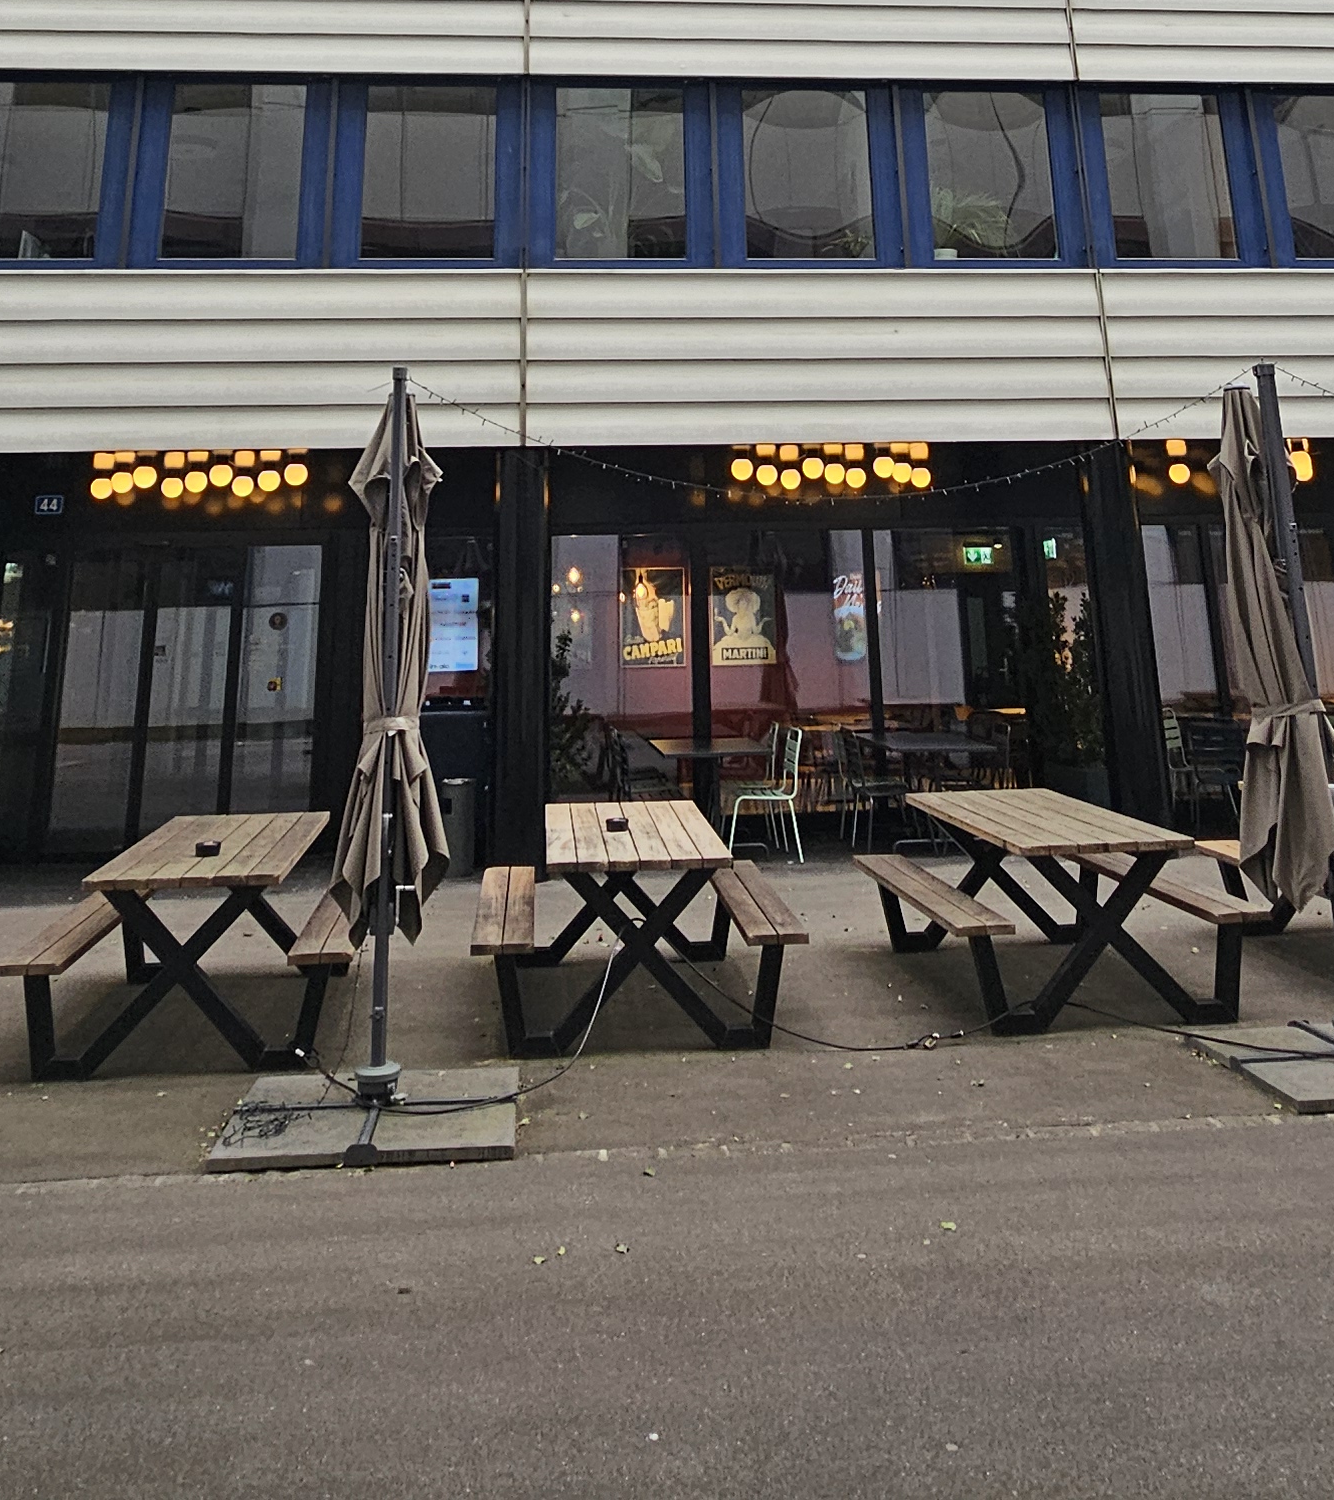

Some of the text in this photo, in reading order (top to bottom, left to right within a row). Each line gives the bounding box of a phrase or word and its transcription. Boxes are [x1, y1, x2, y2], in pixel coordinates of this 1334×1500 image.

[40, 498, 58, 511] 44
[833, 575, 864, 599] Dail
[622, 637, 683, 661] CAMPARI
[722, 648, 767, 660] MARTINI
